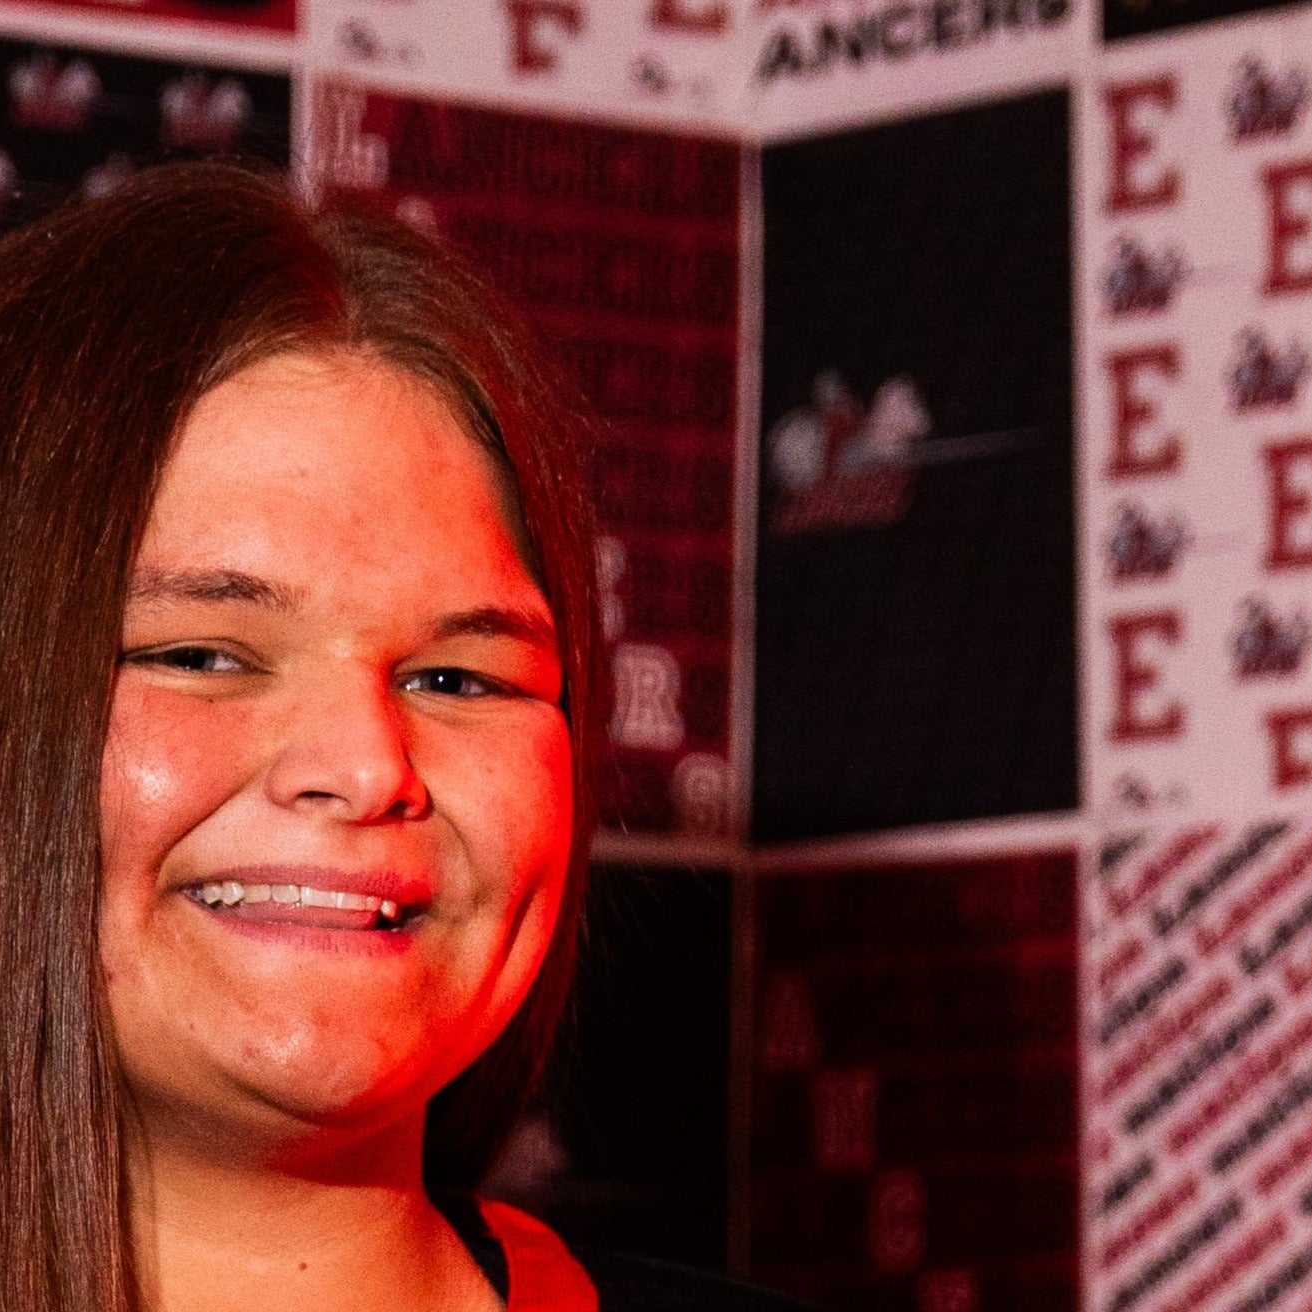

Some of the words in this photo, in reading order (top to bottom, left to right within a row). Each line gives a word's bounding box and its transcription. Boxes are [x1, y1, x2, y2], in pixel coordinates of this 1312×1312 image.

[1103, 70, 1182, 218] E
[1105, 343, 1184, 484] E
[1107, 609, 1186, 744] E
